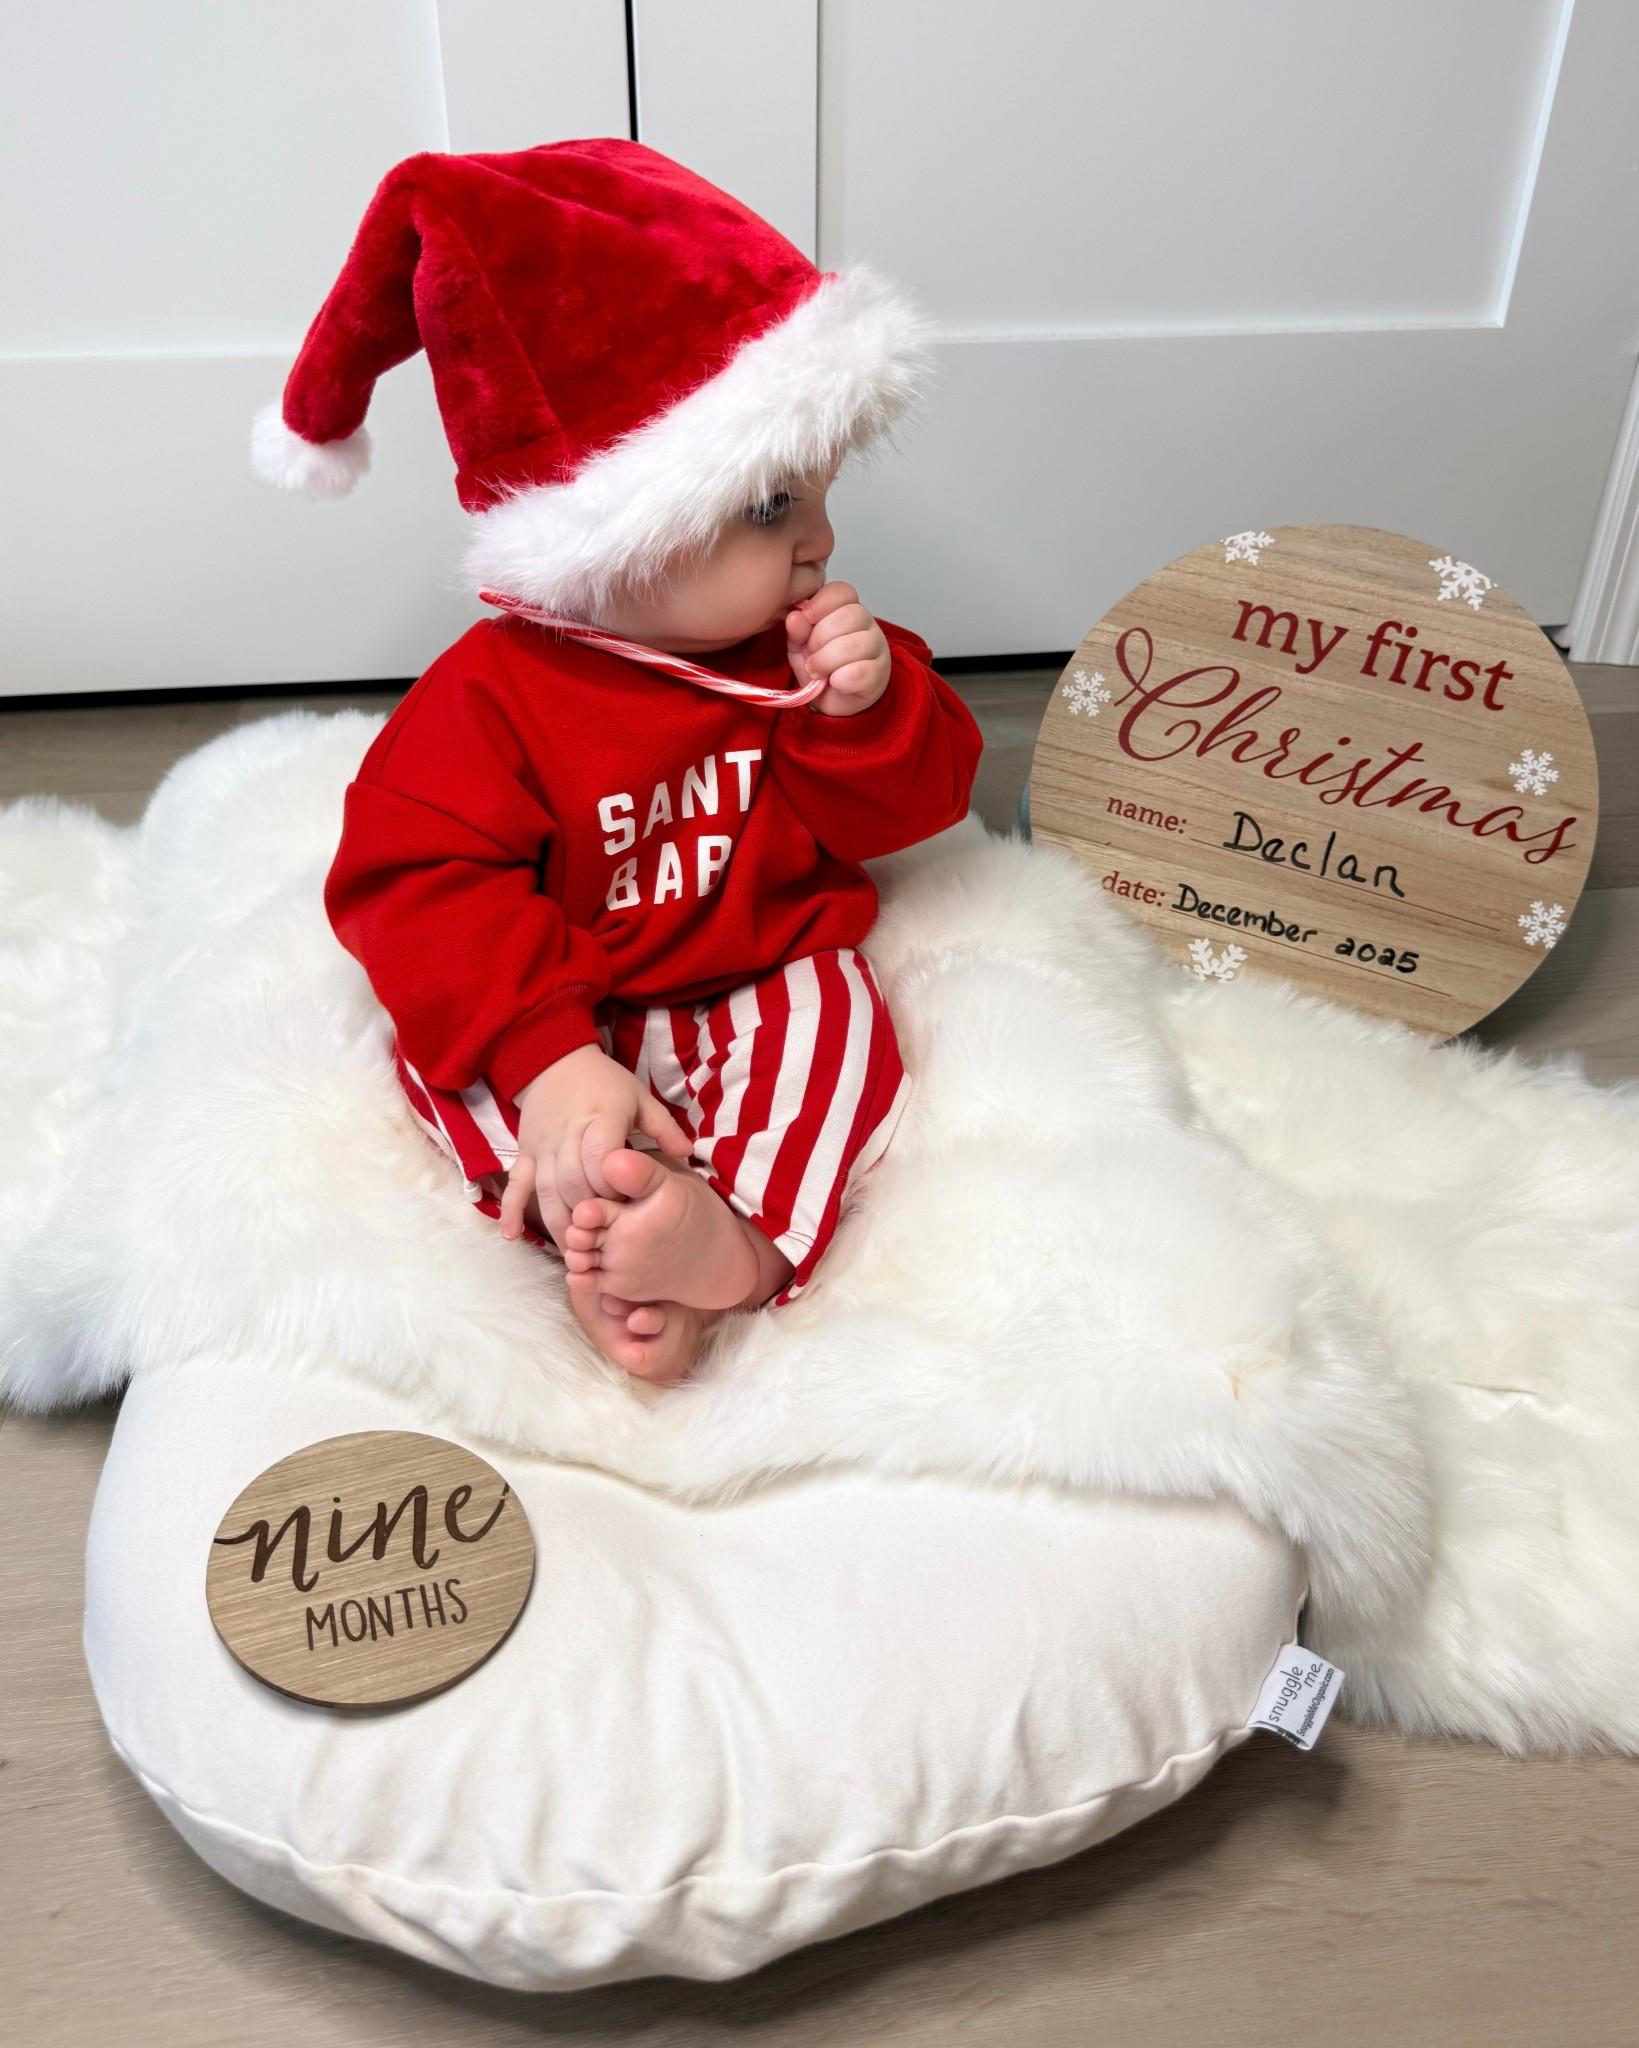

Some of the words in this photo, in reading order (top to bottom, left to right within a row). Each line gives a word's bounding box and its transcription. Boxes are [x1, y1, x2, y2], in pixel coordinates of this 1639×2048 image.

[1230, 599, 1348, 675] my
[1360, 620, 1514, 711] first
[1113, 627, 1577, 864] Christmas
[1106, 796, 1188, 835] name:
[1222, 811, 1405, 897] Declan
[1101, 870, 1166, 907] date:
[1171, 882, 1318, 944] December
[1335, 936, 1419, 974] 2025
[213, 1482, 510, 1592] nine
[306, 1578, 468, 1651] MONTHS
[1268, 1666, 1304, 1723] snuggle
[1296, 1667, 1335, 1737] SnuggleMeOrganic.com
